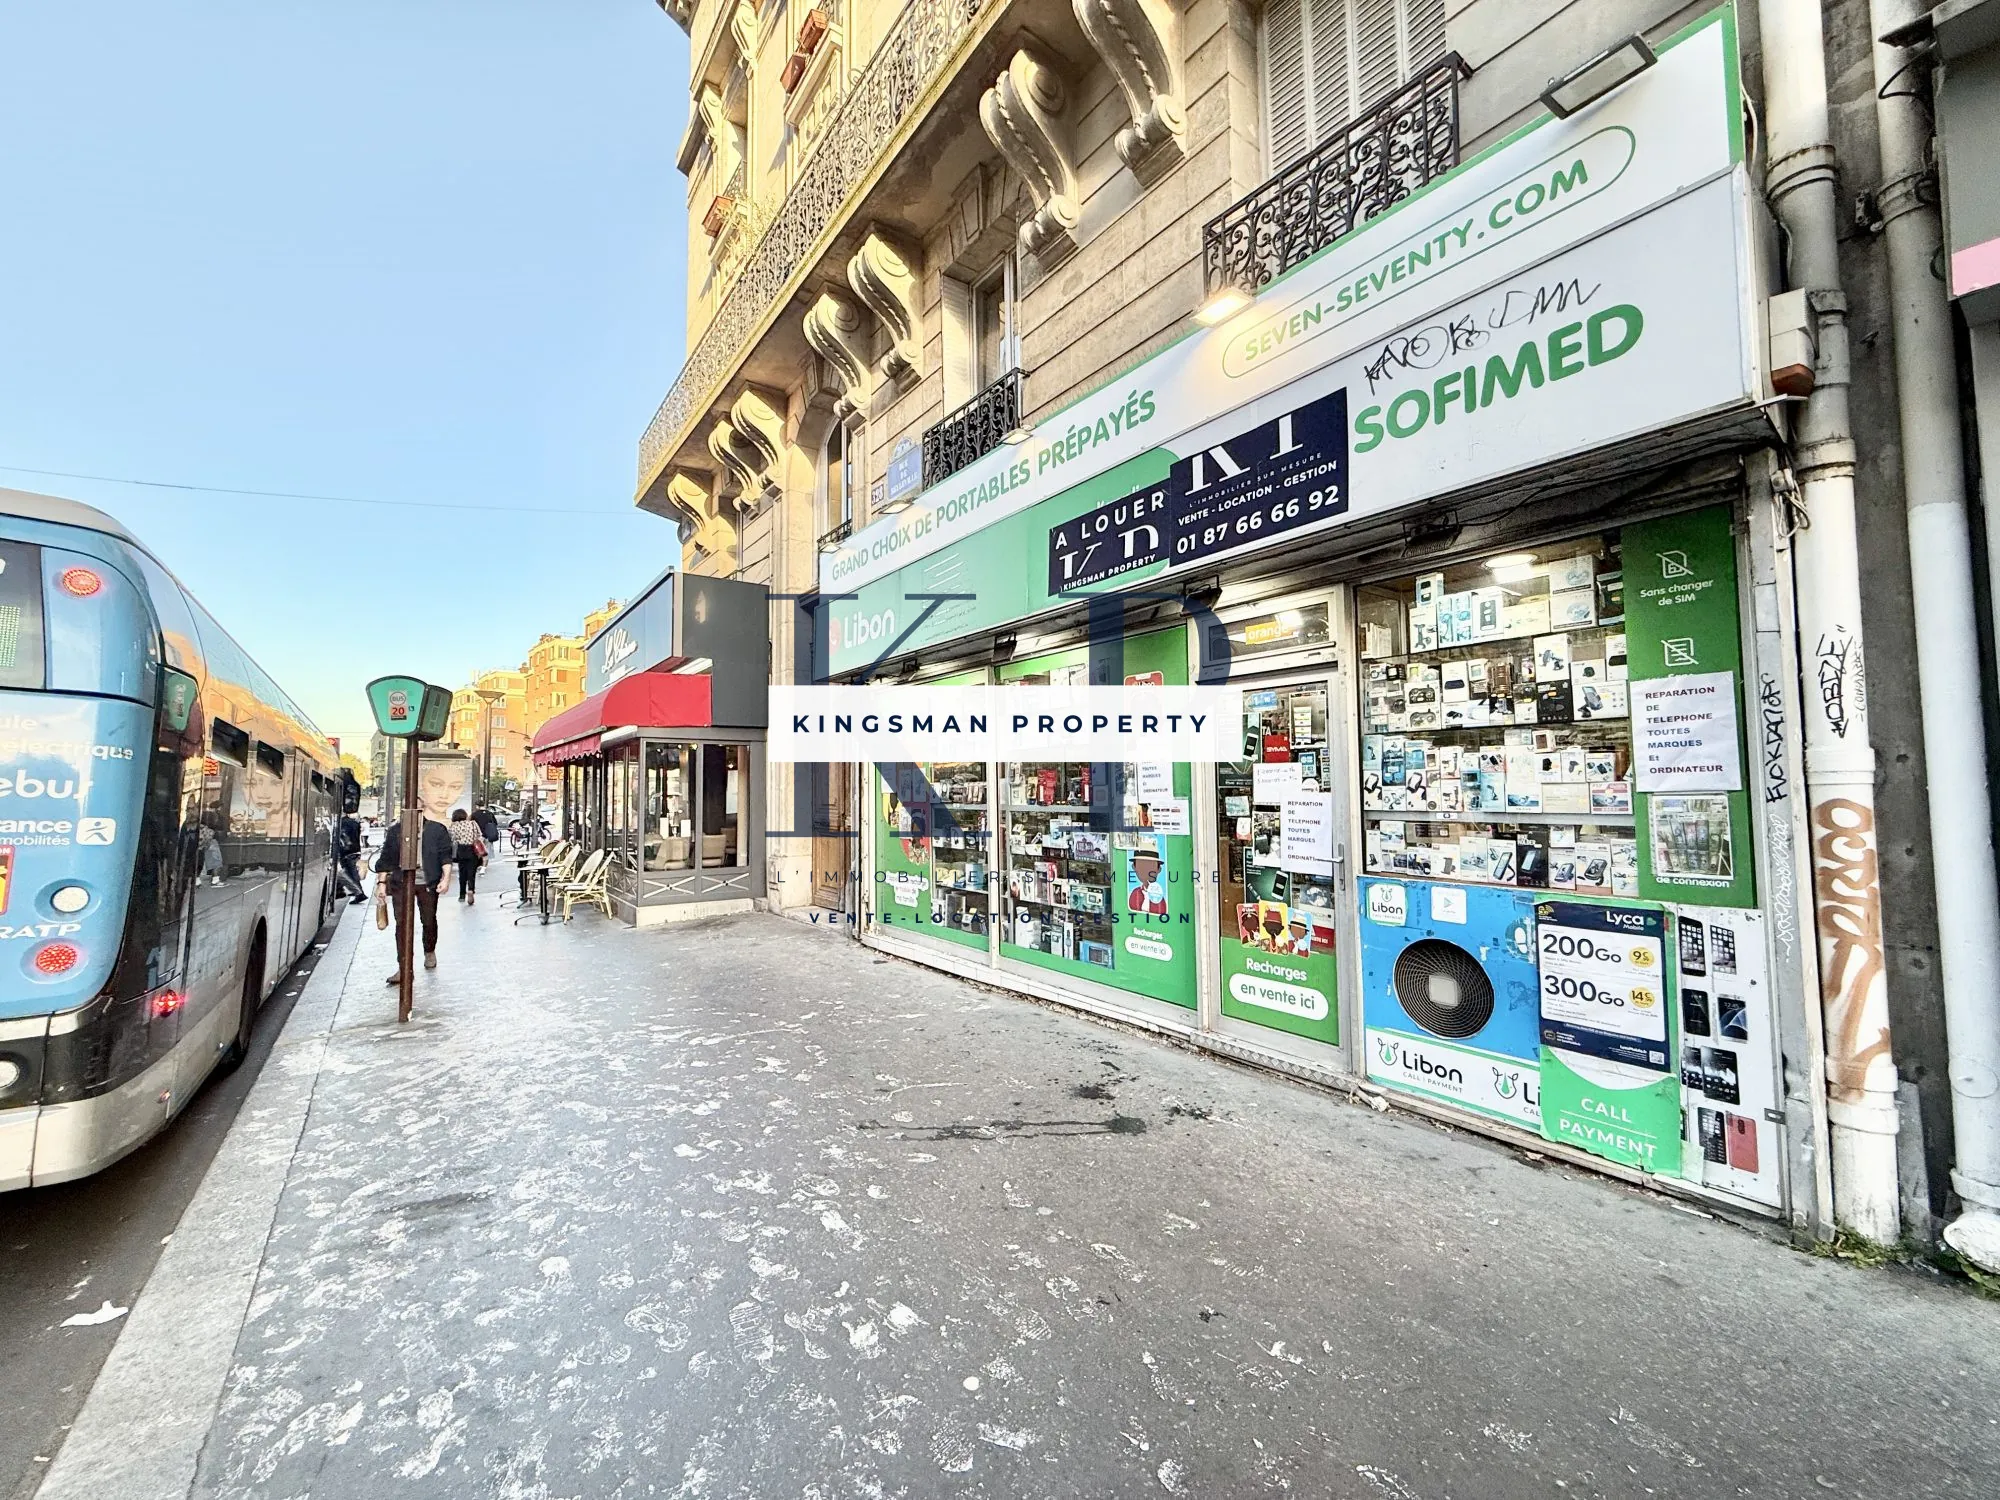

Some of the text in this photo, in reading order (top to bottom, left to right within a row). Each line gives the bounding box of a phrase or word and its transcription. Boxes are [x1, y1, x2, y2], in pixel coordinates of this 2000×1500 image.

[1244, 158, 1588, 362] SEVEN-SEVENTY.COM
[1354, 303, 1645, 454] SOFIMED
[1257, 470, 1276, 482] SUR
[1281, 452, 1323, 473] MESURE
[832, 389, 1157, 581] GRAND CHOIX DE PORTABLES PRÉPAYÉS
[1178, 507, 1209, 527] VENTE
[1218, 484, 1273, 513] LOCATION
[1283, 460, 1338, 488] GESTION
[1055, 491, 1165, 550] A LOUER
[1176, 485, 1340, 555] 01 87 66 66 92
[1063, 571, 1105, 591] KINGSMAN
[1108, 553, 1156, 576] PROPERTY
[1640, 579, 1714, 598] Sans changer
[1658, 593, 1696, 606] de SIM
[844, 609, 895, 649] Libon
[1645, 686, 1715, 699] REPARATION
[392, 706, 405, 716] 20
[1646, 704, 1660, 712] DE
[1646, 713, 1713, 724] TELEPHONE
[1647, 727, 1691, 736] TOUTES
[1647, 739, 1703, 749] MARQUES
[1649, 765, 1724, 774] ORDINATEUR
[1672, 876, 1730, 888] connexion
[1372, 902, 1403, 914] Libon
[1606, 911, 1645, 926] Lyca
[0, 923, 82, 939] RATP
[1246, 957, 1308, 981] Recharges
[1240, 983, 1315, 1010] en vente ici
[1402, 1050, 1463, 1084] Libon
[1403, 1071, 1463, 1093] CALL PAYMENT
[1523, 1106, 1540, 1117] CAL
[1581, 1098, 1632, 1124] CALL
[1559, 1118, 1658, 1161] PAYMENT
